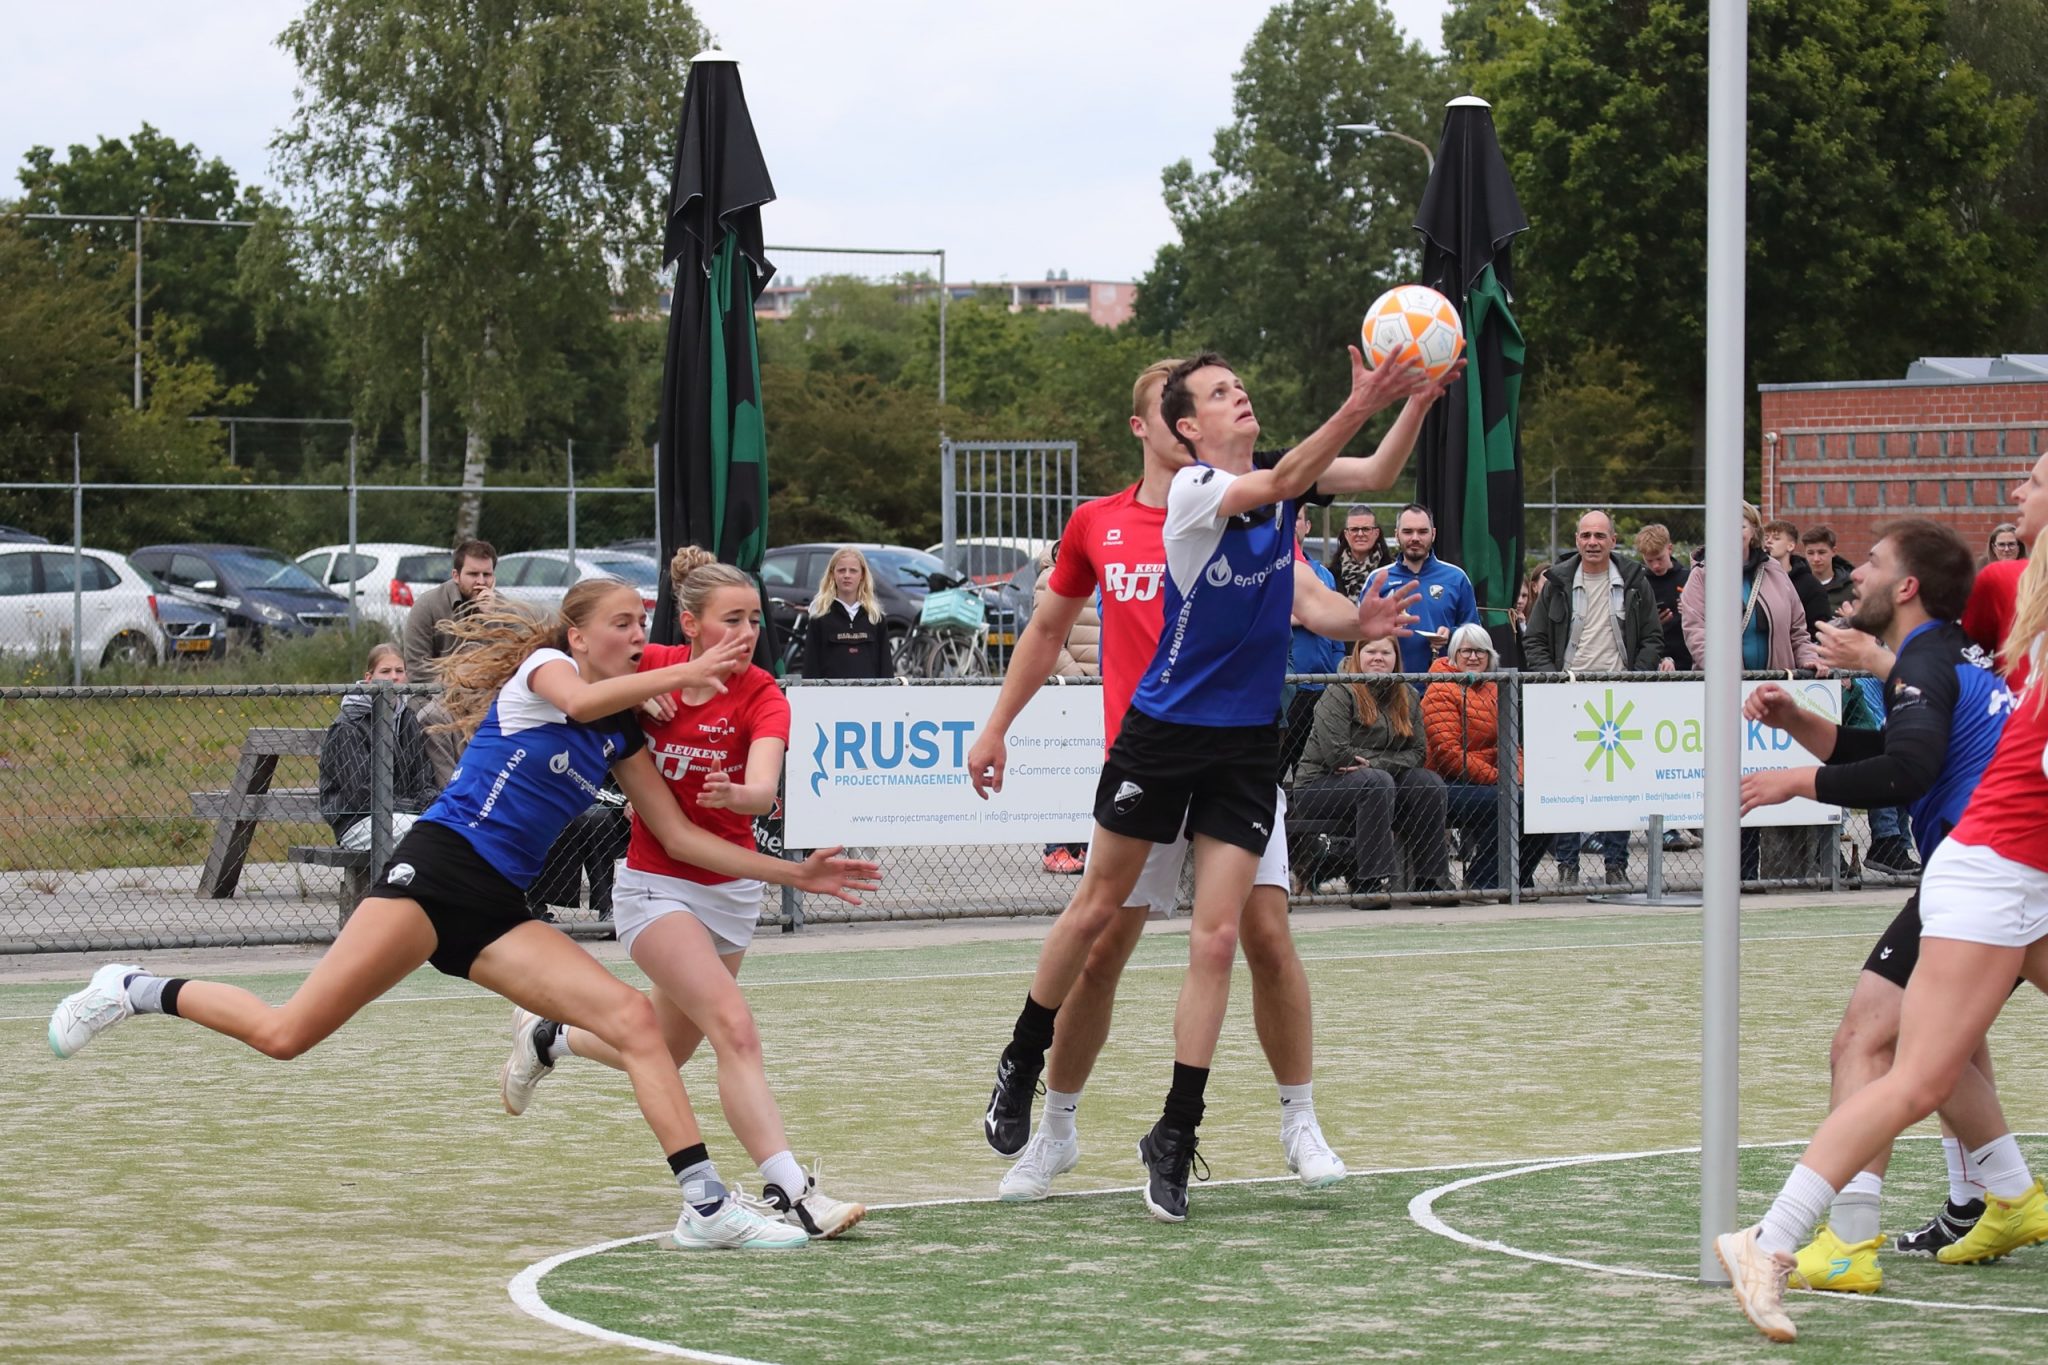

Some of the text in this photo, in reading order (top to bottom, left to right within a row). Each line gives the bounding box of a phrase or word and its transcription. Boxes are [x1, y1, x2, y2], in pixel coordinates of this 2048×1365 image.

[1168, 601, 1193, 666] REEHORST
[1009, 735, 1105, 749] Online projectmanag
[1654, 719, 1794, 753] oakb
[663, 743, 728, 760] KEUKENS
[835, 721, 975, 769] RUST
[506, 748, 527, 771] CKV
[689, 763, 744, 774] HOEVAKEN
[1009, 763, 1071, 776] e-Commerce
[834, 773, 969, 786] PROJECTMANAGEMENT
[478, 769, 511, 821] REEHORST
[1540, 795, 1585, 805] Boekhouding
[1589, 793, 1641, 804] Jaarrekeningen
[1645, 790, 1692, 803] Bedrijfsadvies
[852, 811, 977, 824] www.rustprojectmanagement.nl
